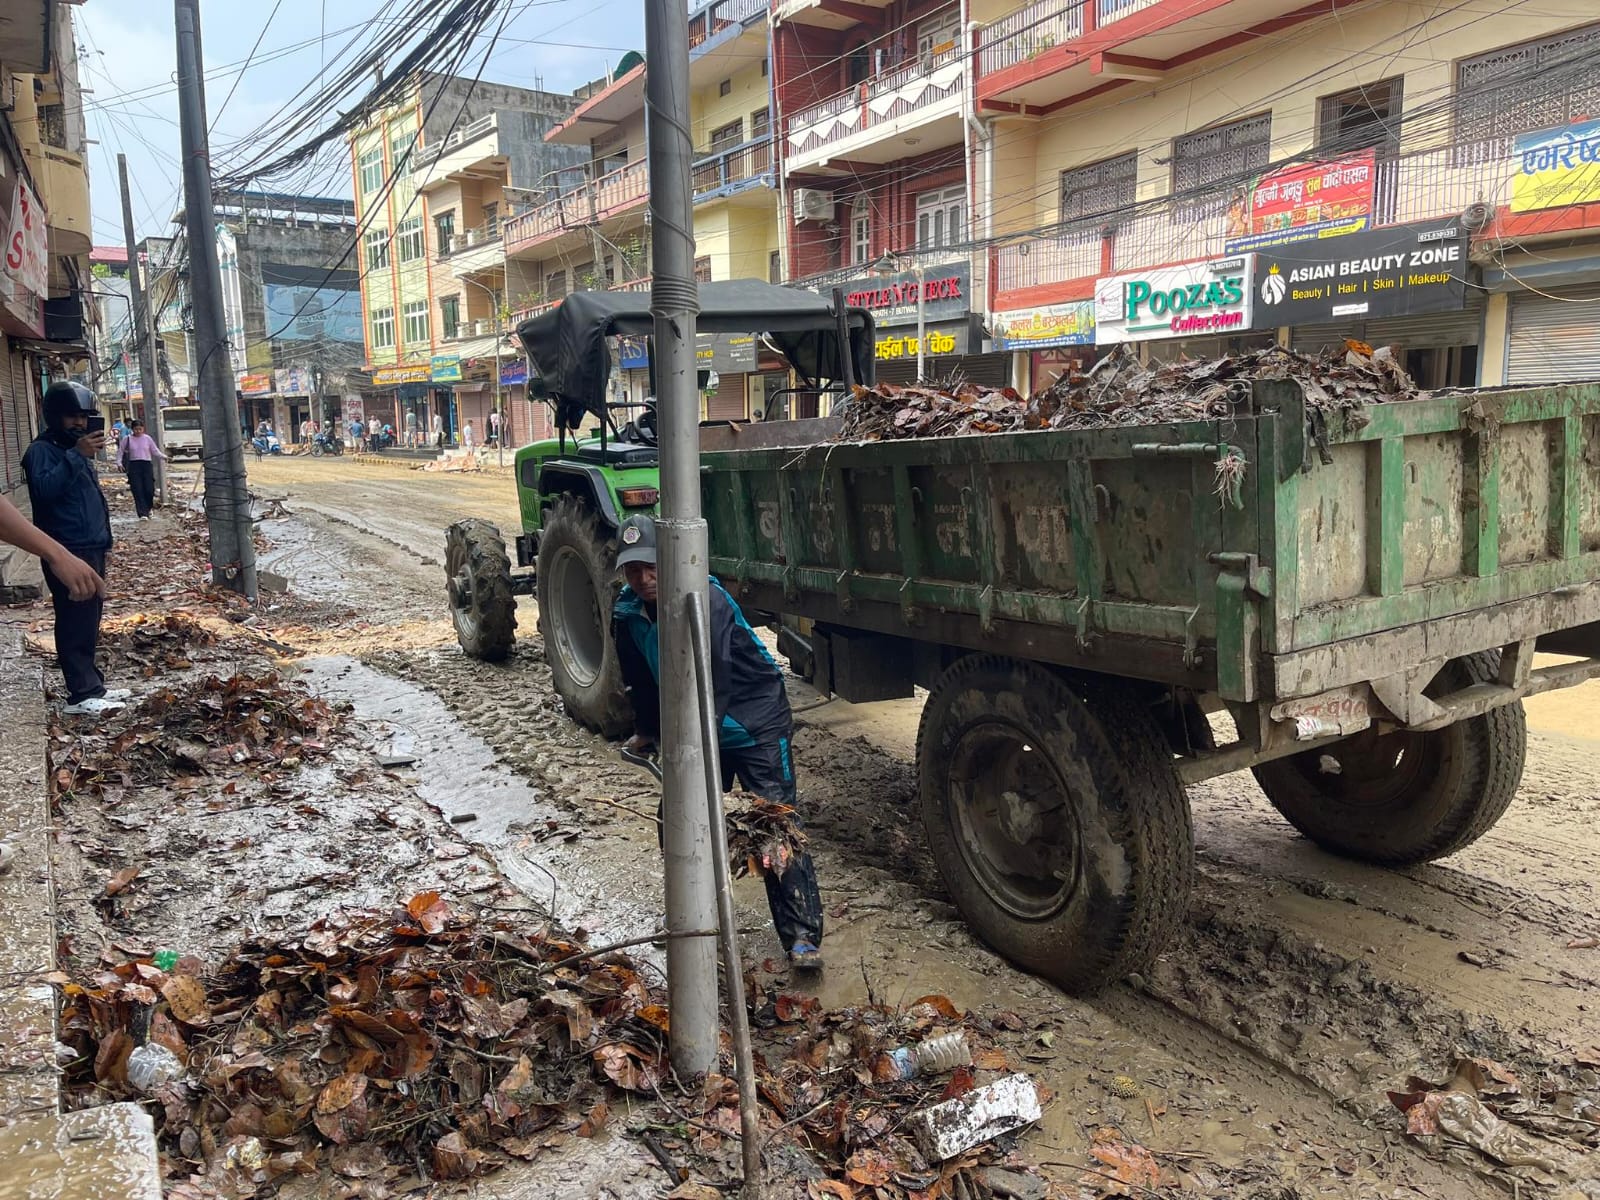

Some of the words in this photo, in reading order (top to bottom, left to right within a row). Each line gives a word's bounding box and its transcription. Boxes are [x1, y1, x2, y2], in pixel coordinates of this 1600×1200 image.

[1289, 263, 1335, 285] ASIAN
[1339, 253, 1405, 277] BEAUTY
[1409, 246, 1460, 268] ZONE
[1292, 286, 1323, 301] Beauty
[1337, 282, 1357, 295] Hair
[1372, 277, 1395, 291] Skin
[1408, 271, 1451, 287] Makeup
[846, 290, 891, 309] STYLE
[895, 304, 918, 316] BUTWAL
[1170, 310, 1243, 333] Collection
